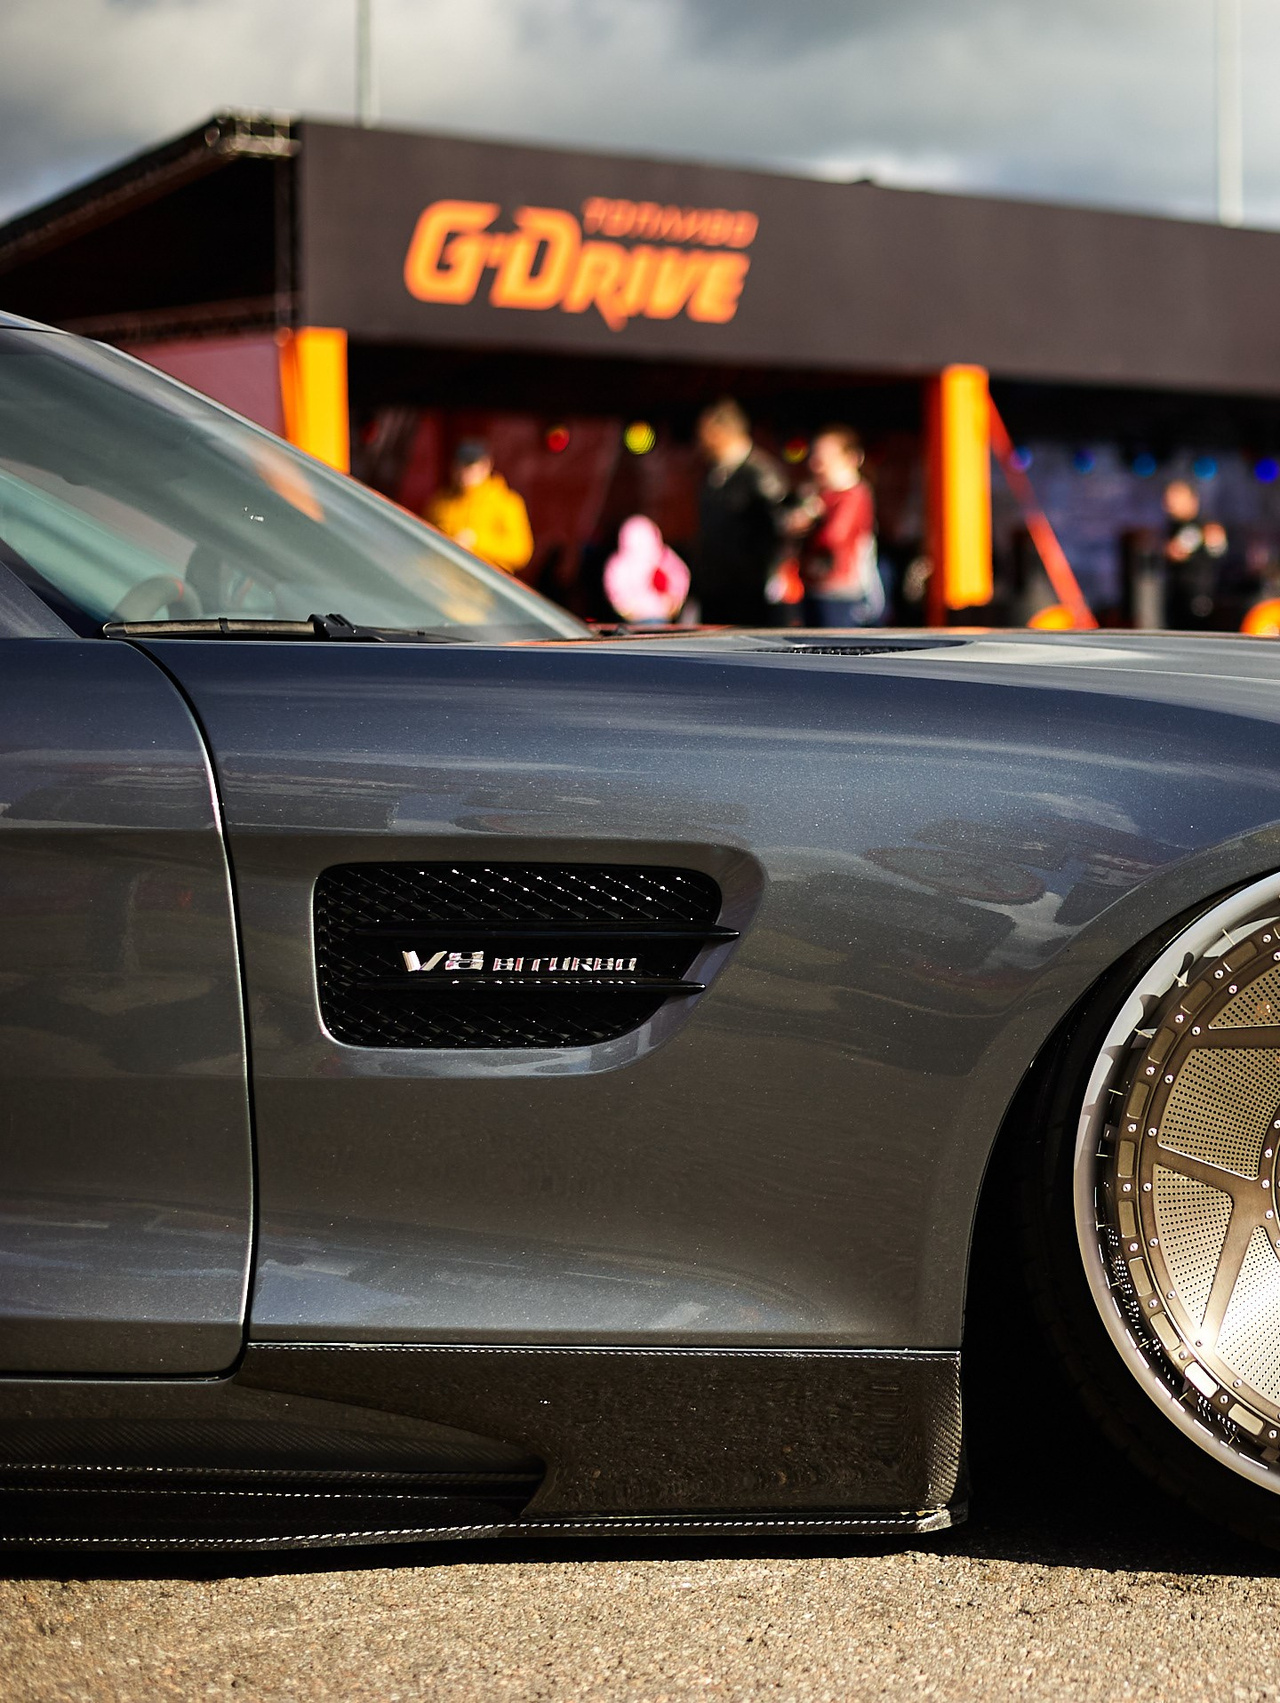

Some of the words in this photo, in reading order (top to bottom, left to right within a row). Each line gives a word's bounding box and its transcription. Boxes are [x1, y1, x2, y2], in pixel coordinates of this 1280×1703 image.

[404, 200, 751, 331] G-DRIVE
[402, 951, 485, 971] V8
[493, 957, 638, 971] BITURBO
